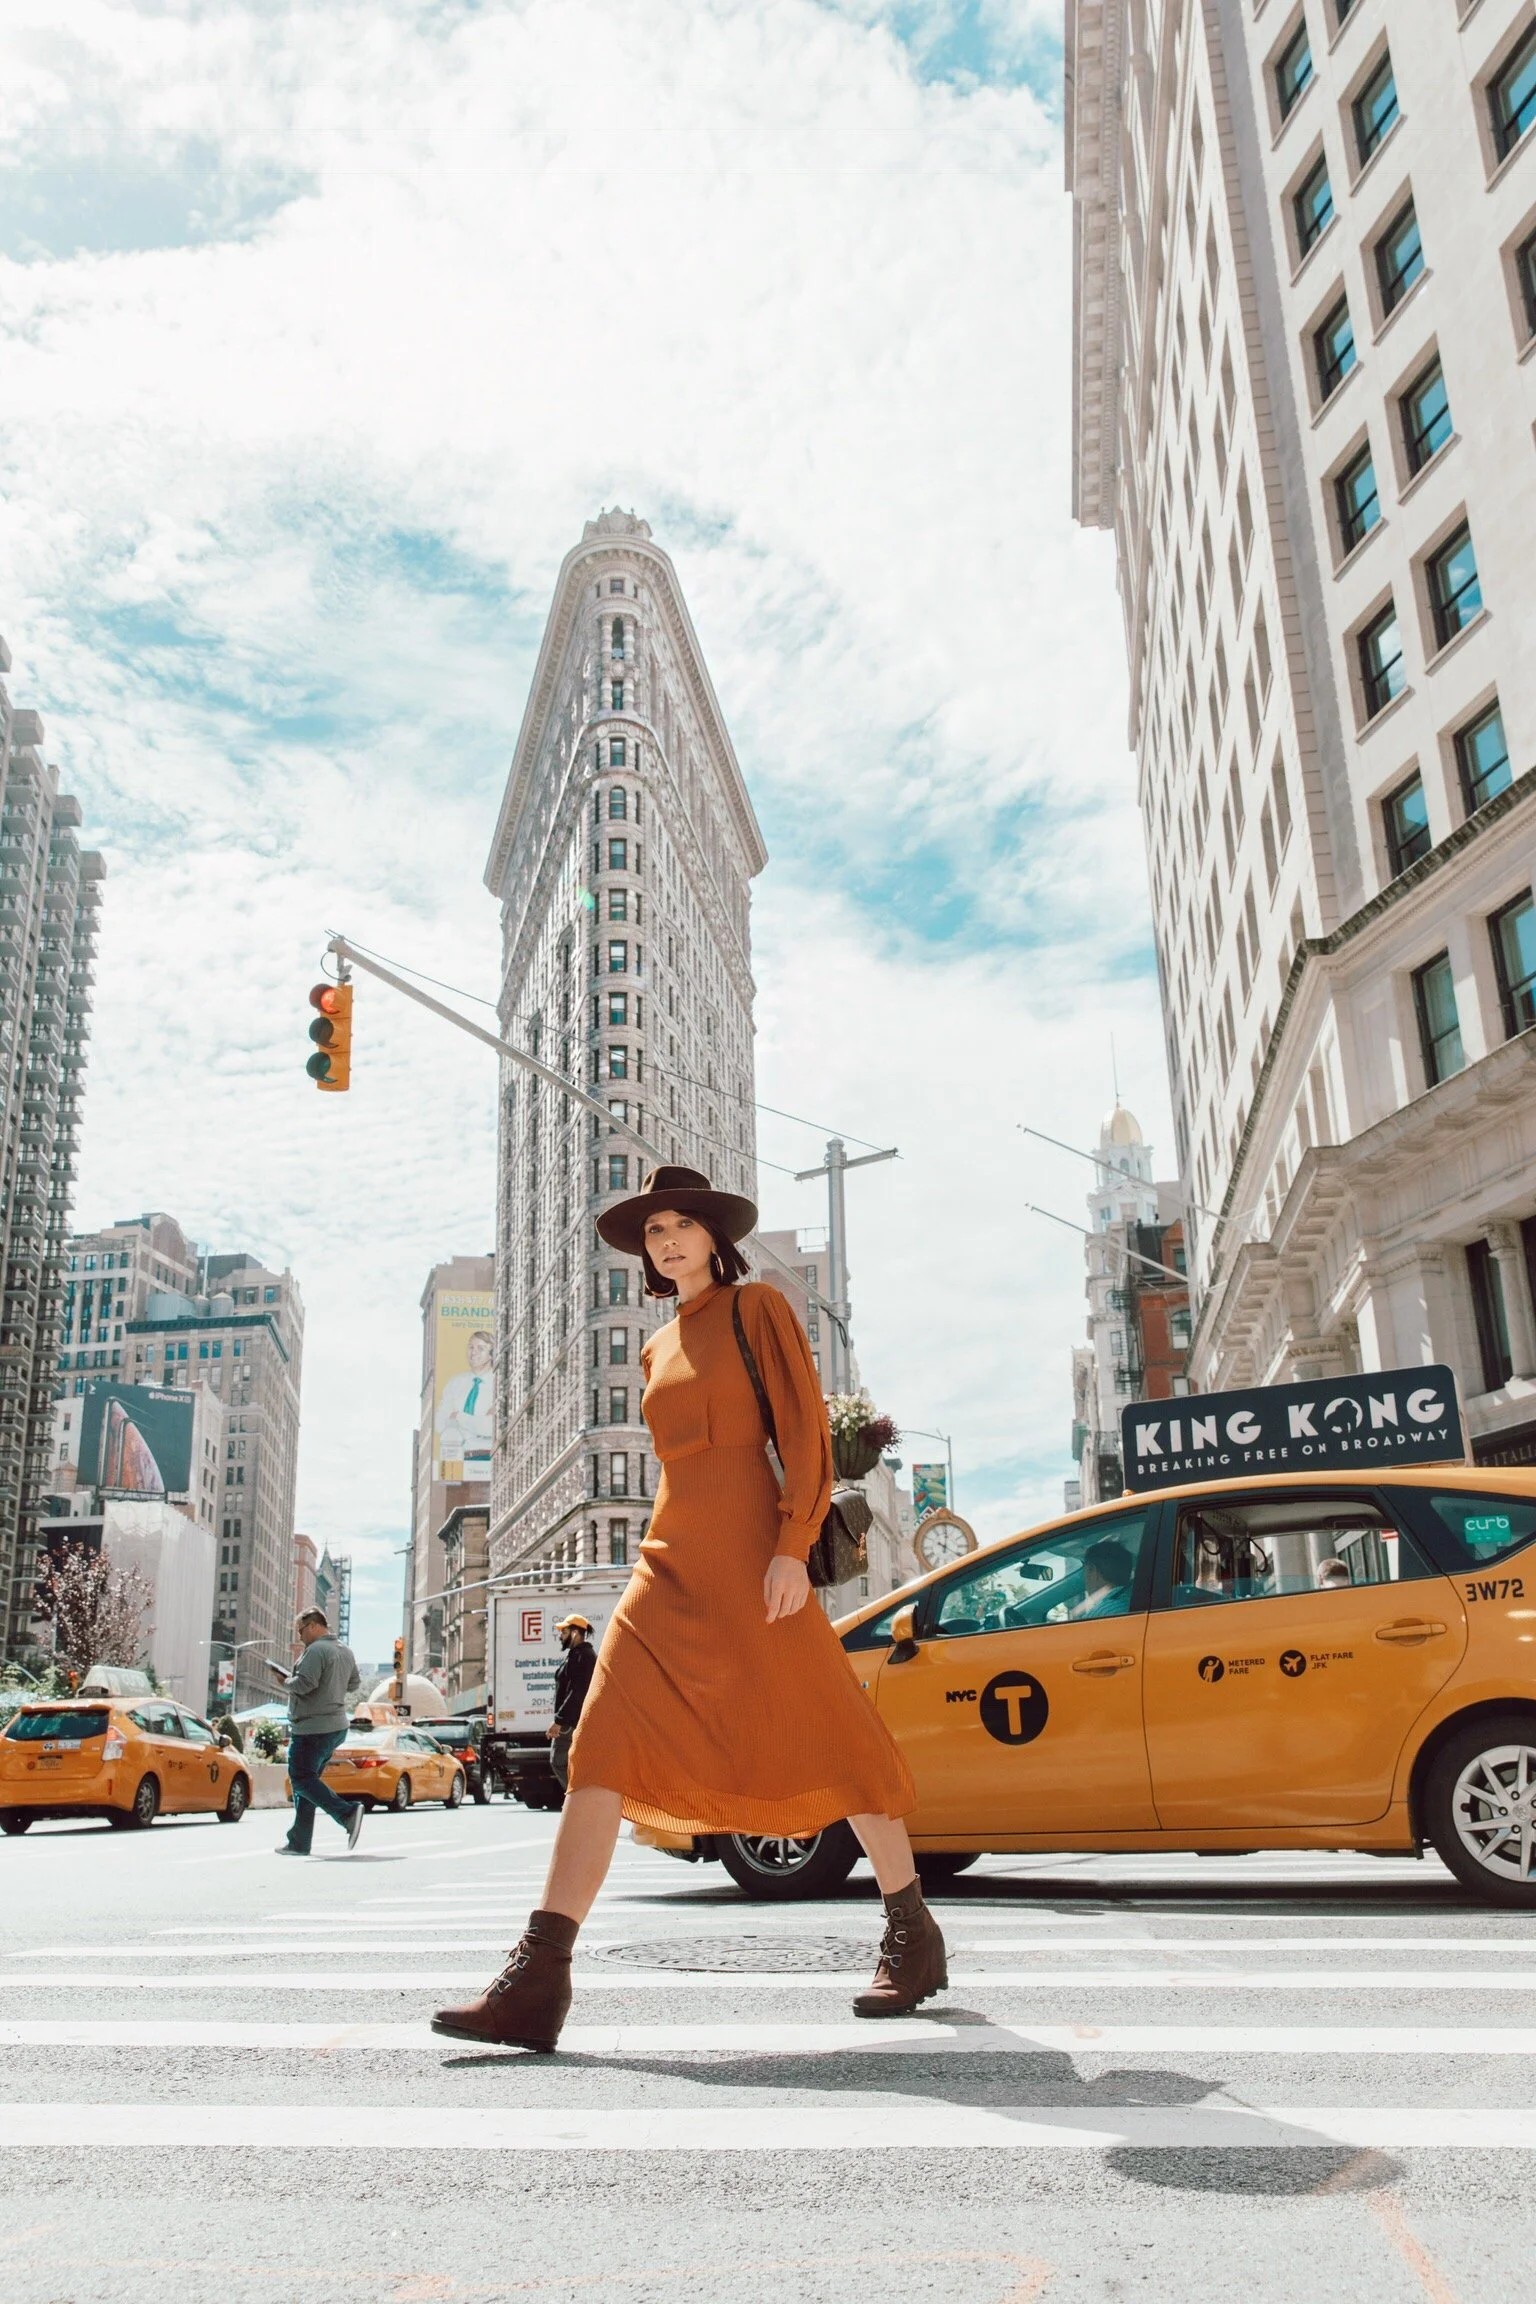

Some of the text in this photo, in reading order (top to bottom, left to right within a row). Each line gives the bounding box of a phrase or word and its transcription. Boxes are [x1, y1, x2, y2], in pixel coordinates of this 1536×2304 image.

[1135, 1388, 1445, 1457] KING KONG
[1137, 1428, 1448, 1475] BREAKING FREE ON BROADWAY
[1494, 1444, 1536, 1467] ITALI
[1465, 1516, 1509, 1531] curb
[1465, 1578, 1524, 1602] 3W72
[1310, 1651, 1353, 1661] FLAT FARE
[1228, 1658, 1266, 1667] METERED
[1311, 1662, 1328, 1670] JFK
[1228, 1667, 1249, 1675] FARE
[527, 1683, 556, 1691] Commerc
[532, 1697, 555, 1706] 201-2
[946, 1690, 977, 1702] NYC
[995, 1685, 1031, 1735] T
